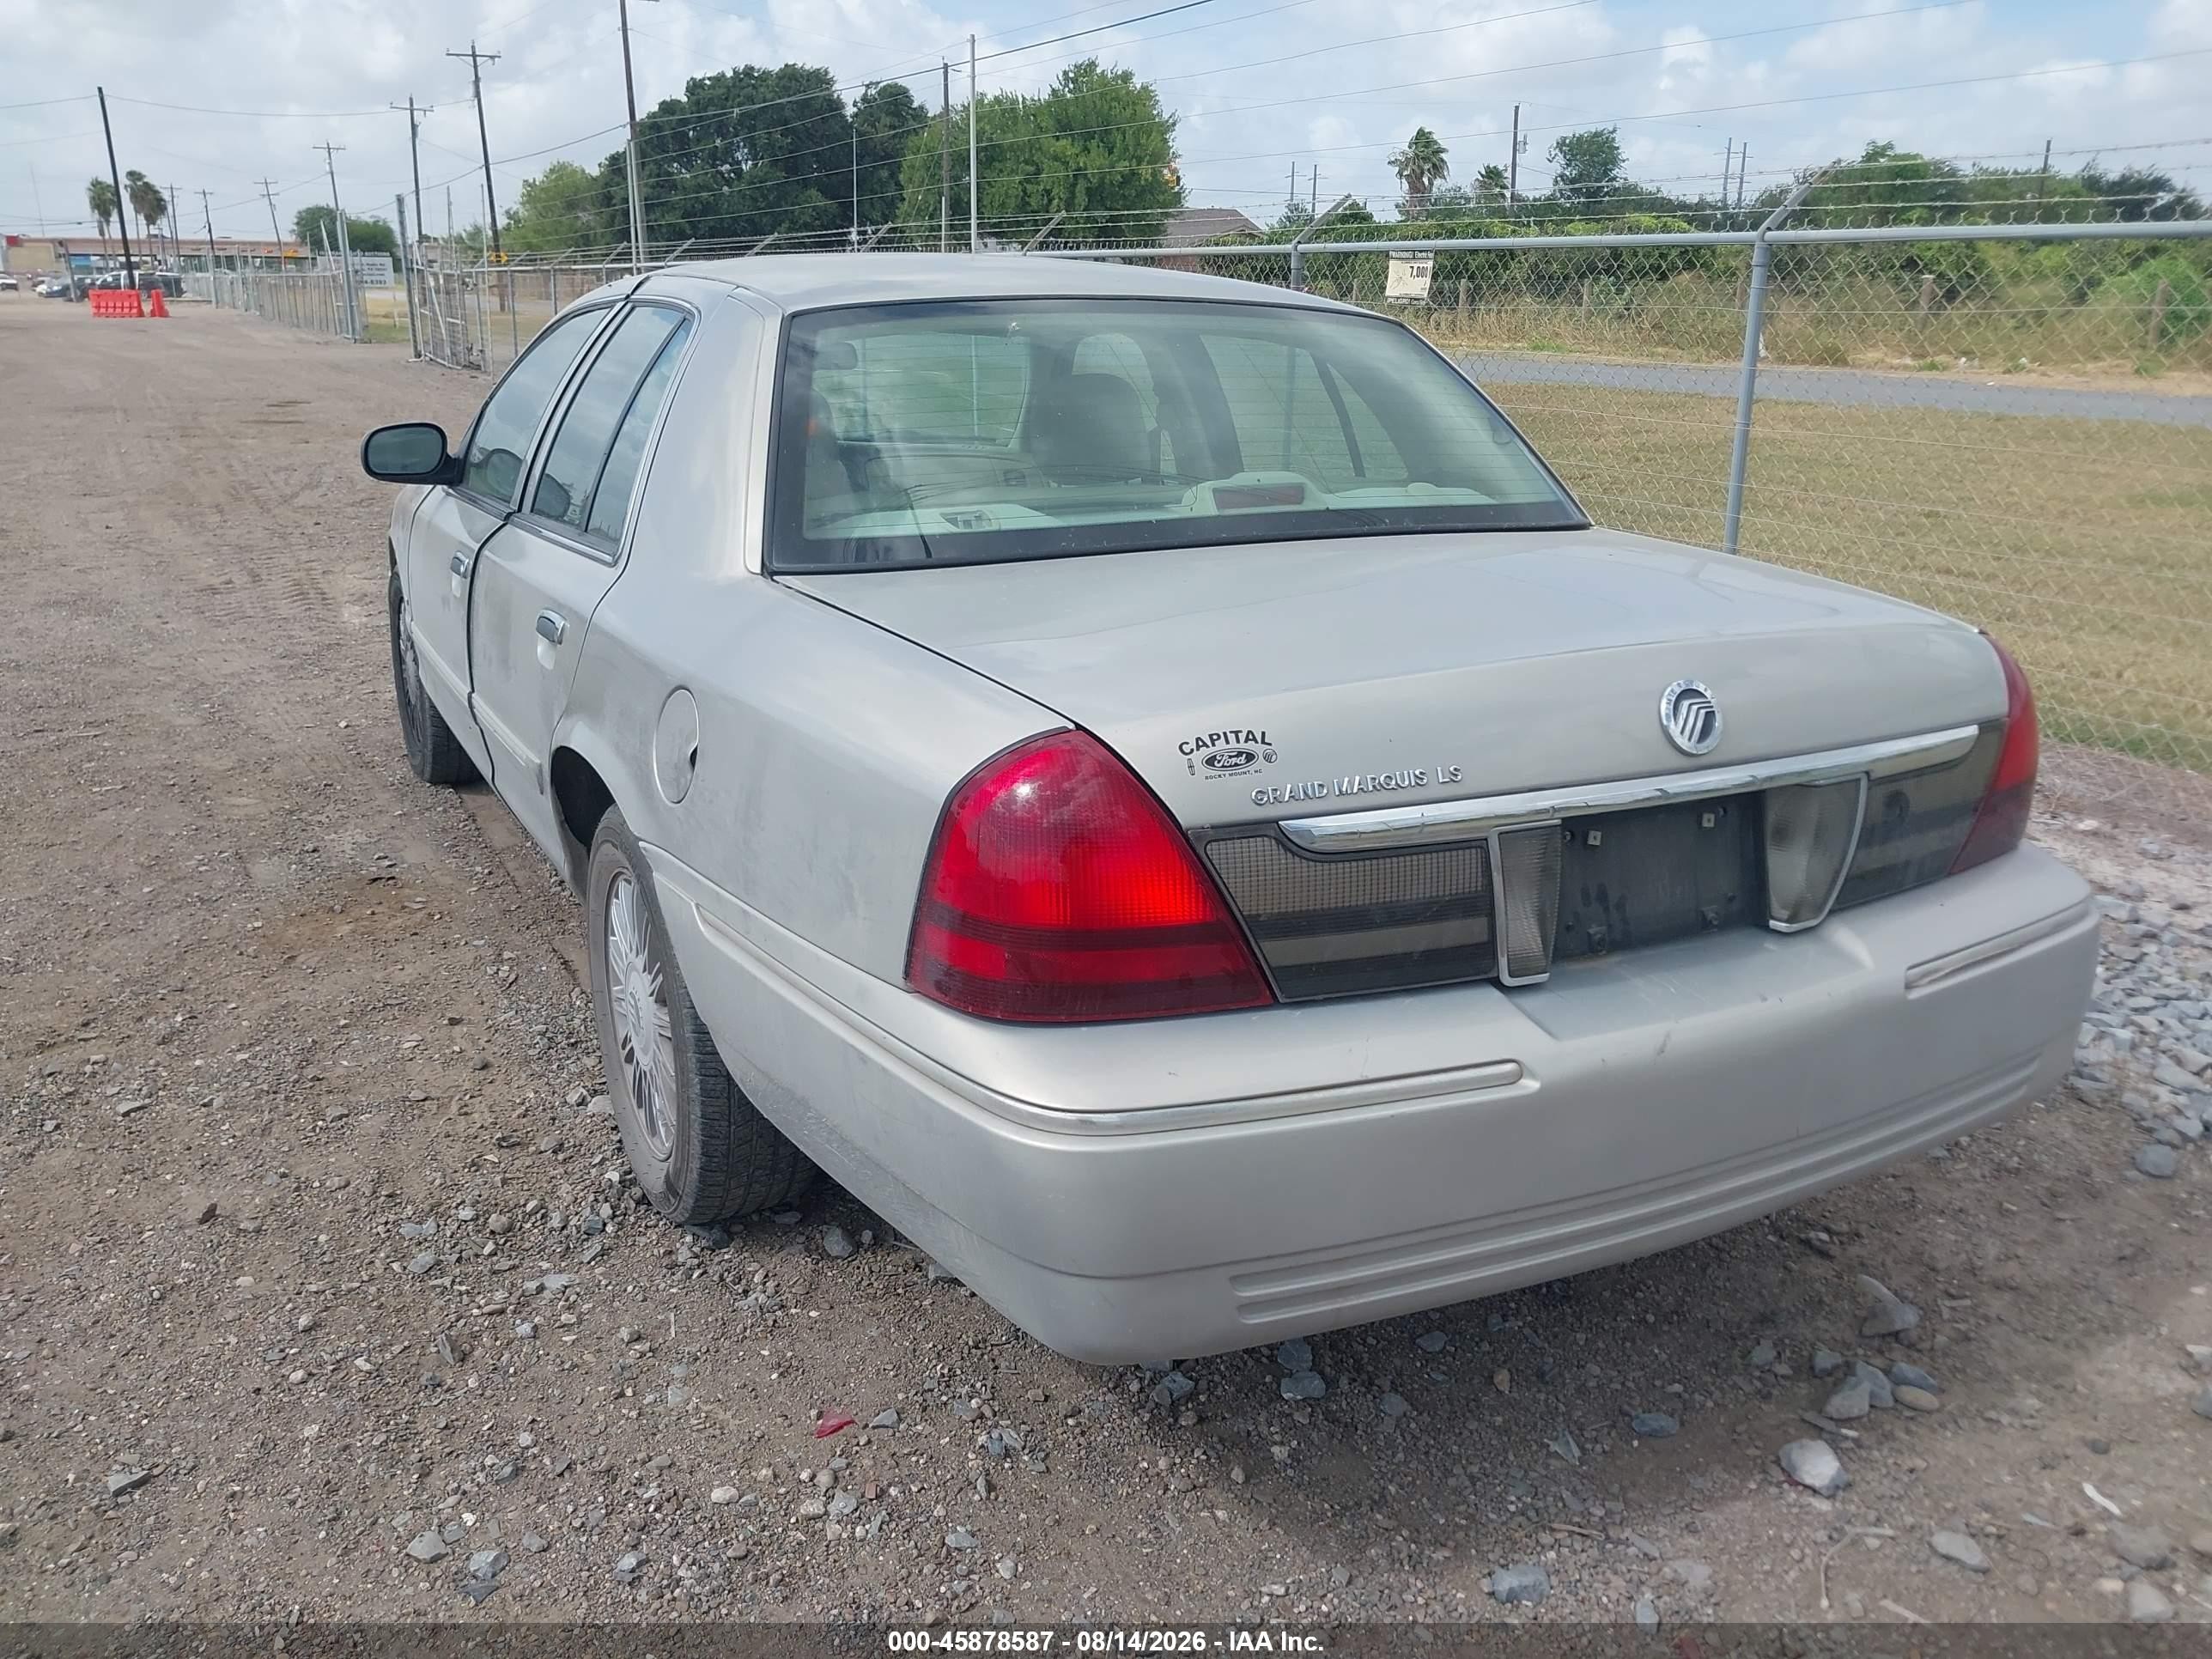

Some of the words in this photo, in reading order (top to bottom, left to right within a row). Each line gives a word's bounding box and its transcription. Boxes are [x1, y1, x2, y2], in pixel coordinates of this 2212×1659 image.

[1409, 265, 1429, 280] 7,000
[1178, 730, 1273, 756] CAPITAL
[1213, 751, 1248, 767] Ford
[1251, 781, 1328, 805] GRAND
[1333, 769, 1428, 797] MARQUIS
[1436, 764, 1463, 783] LS
